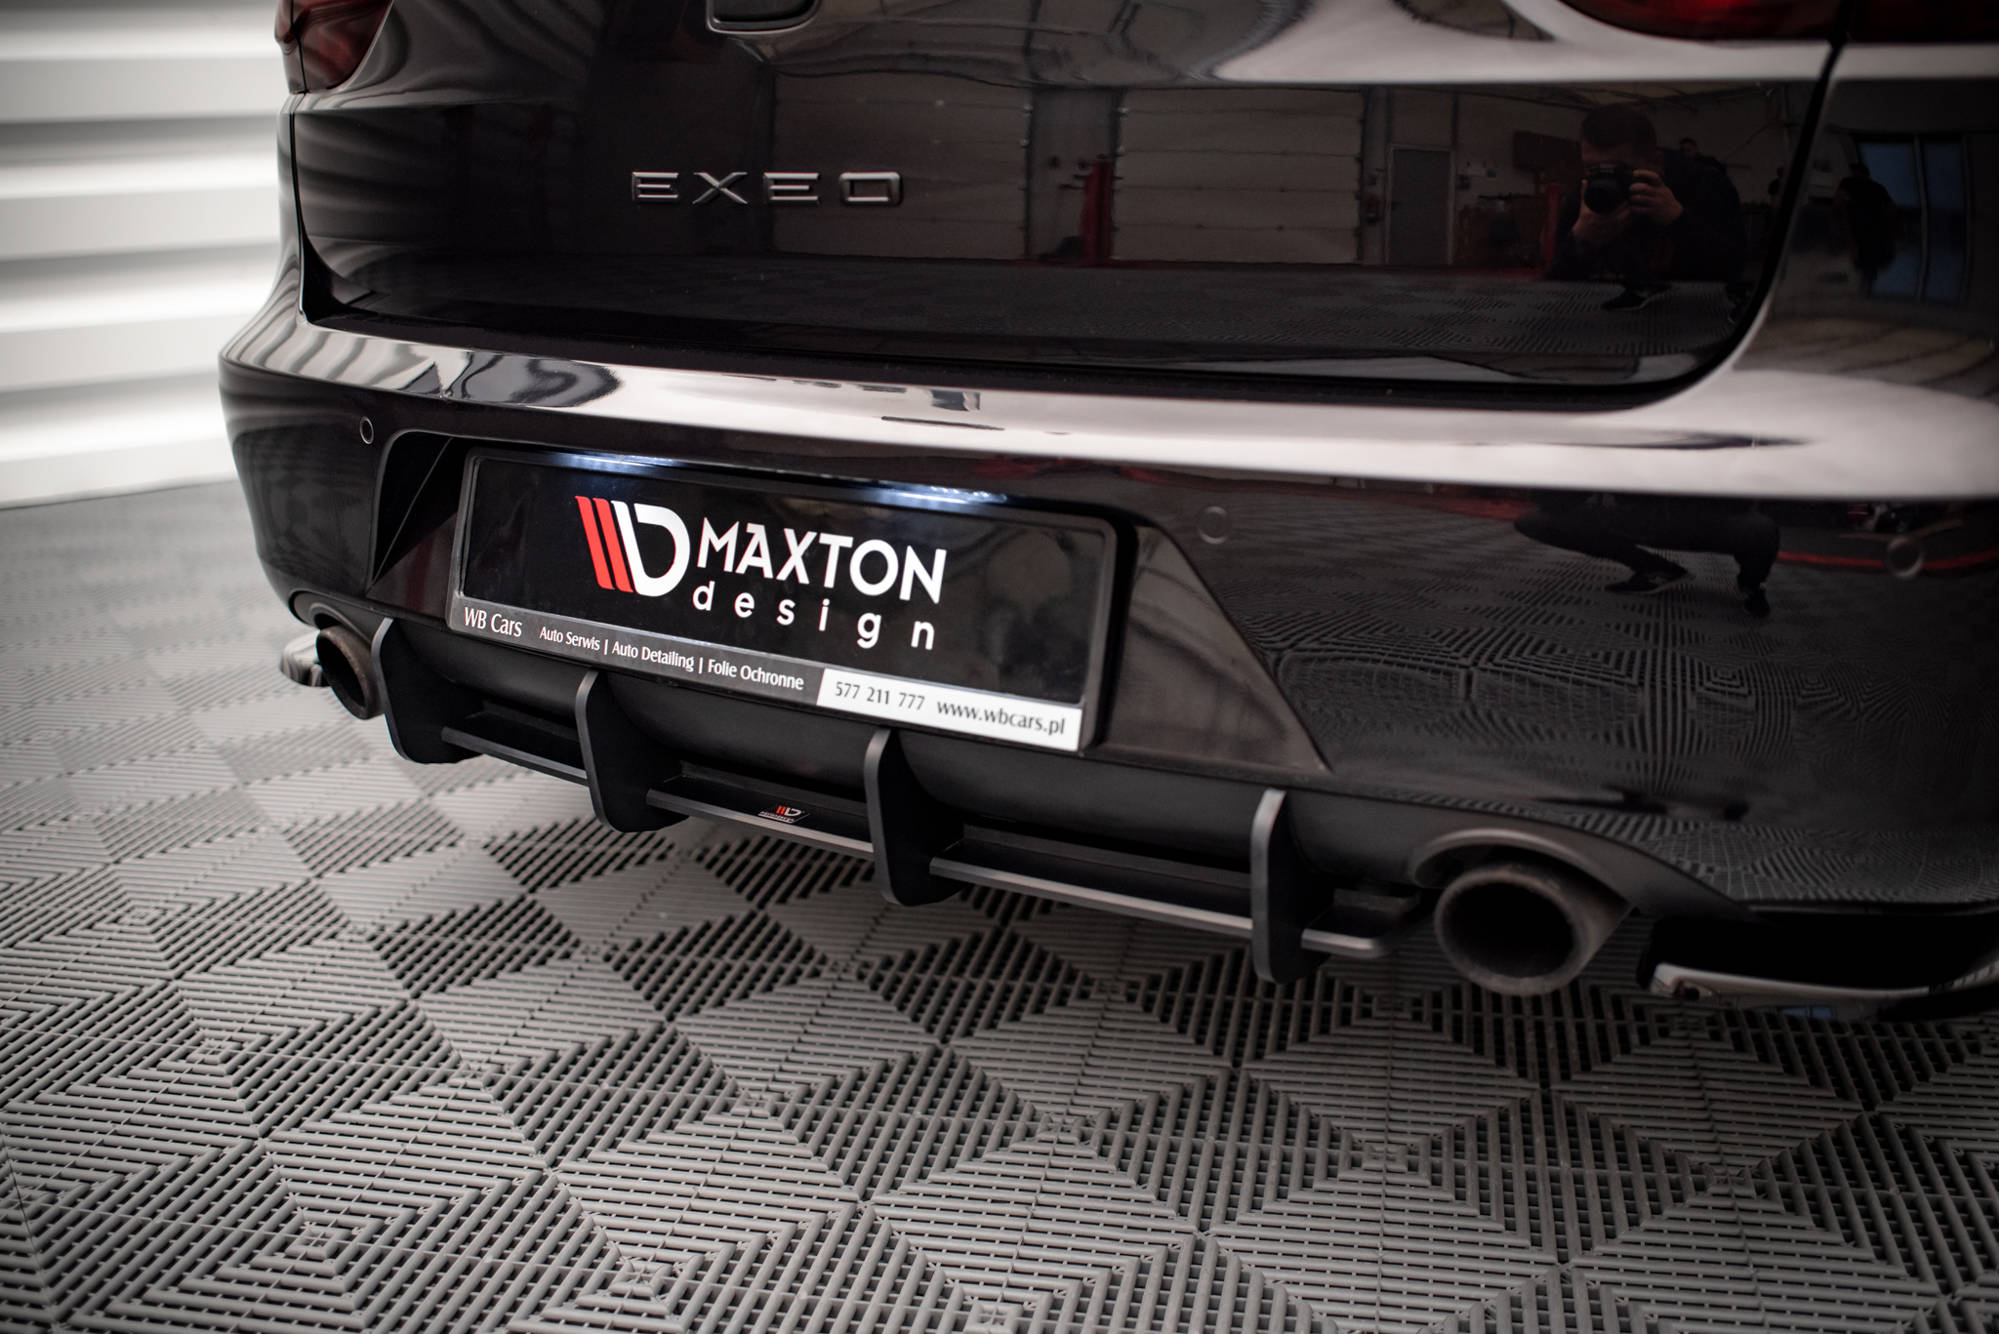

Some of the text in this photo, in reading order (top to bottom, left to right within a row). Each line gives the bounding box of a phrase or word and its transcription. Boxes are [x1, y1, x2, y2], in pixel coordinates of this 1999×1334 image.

[631, 171, 902, 205] EXEO
[696, 516, 948, 605] MAXTON
[463, 606, 487, 630] WB
[490, 613, 523, 638] Cars
[539, 626, 564, 643] Auto
[566, 631, 601, 652] Serwis
[612, 643, 639, 660] Auto
[642, 646, 695, 672] Detailing
[708, 659, 737, 678] Folie
[740, 664, 805, 691] Ochronne
[691, 580, 936, 651] design
[834, 681, 1066, 736] 577 211 777 www.wbcars.pl
